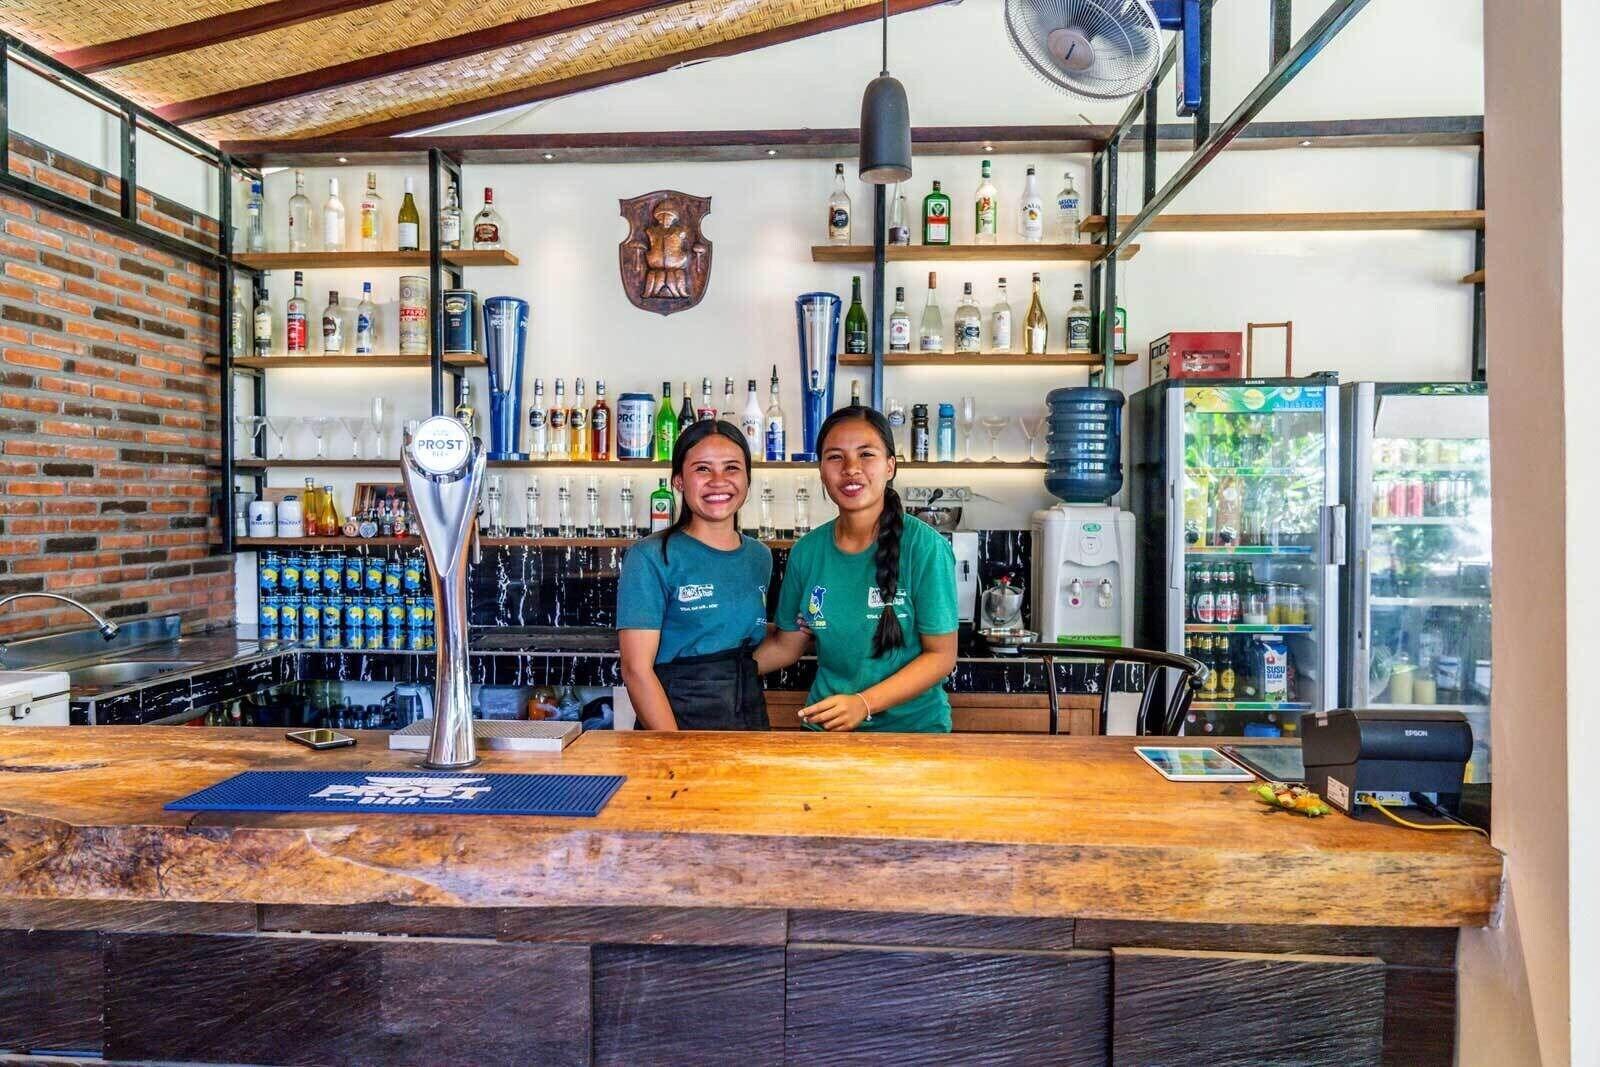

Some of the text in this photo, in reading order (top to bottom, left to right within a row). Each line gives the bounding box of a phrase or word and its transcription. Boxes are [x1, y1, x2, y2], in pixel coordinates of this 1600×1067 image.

[418, 439, 464, 451] PROST
[1266, 665, 1285, 674] SUSU
[1404, 729, 1428, 737] EPSON
[309, 784, 492, 800] PROST
